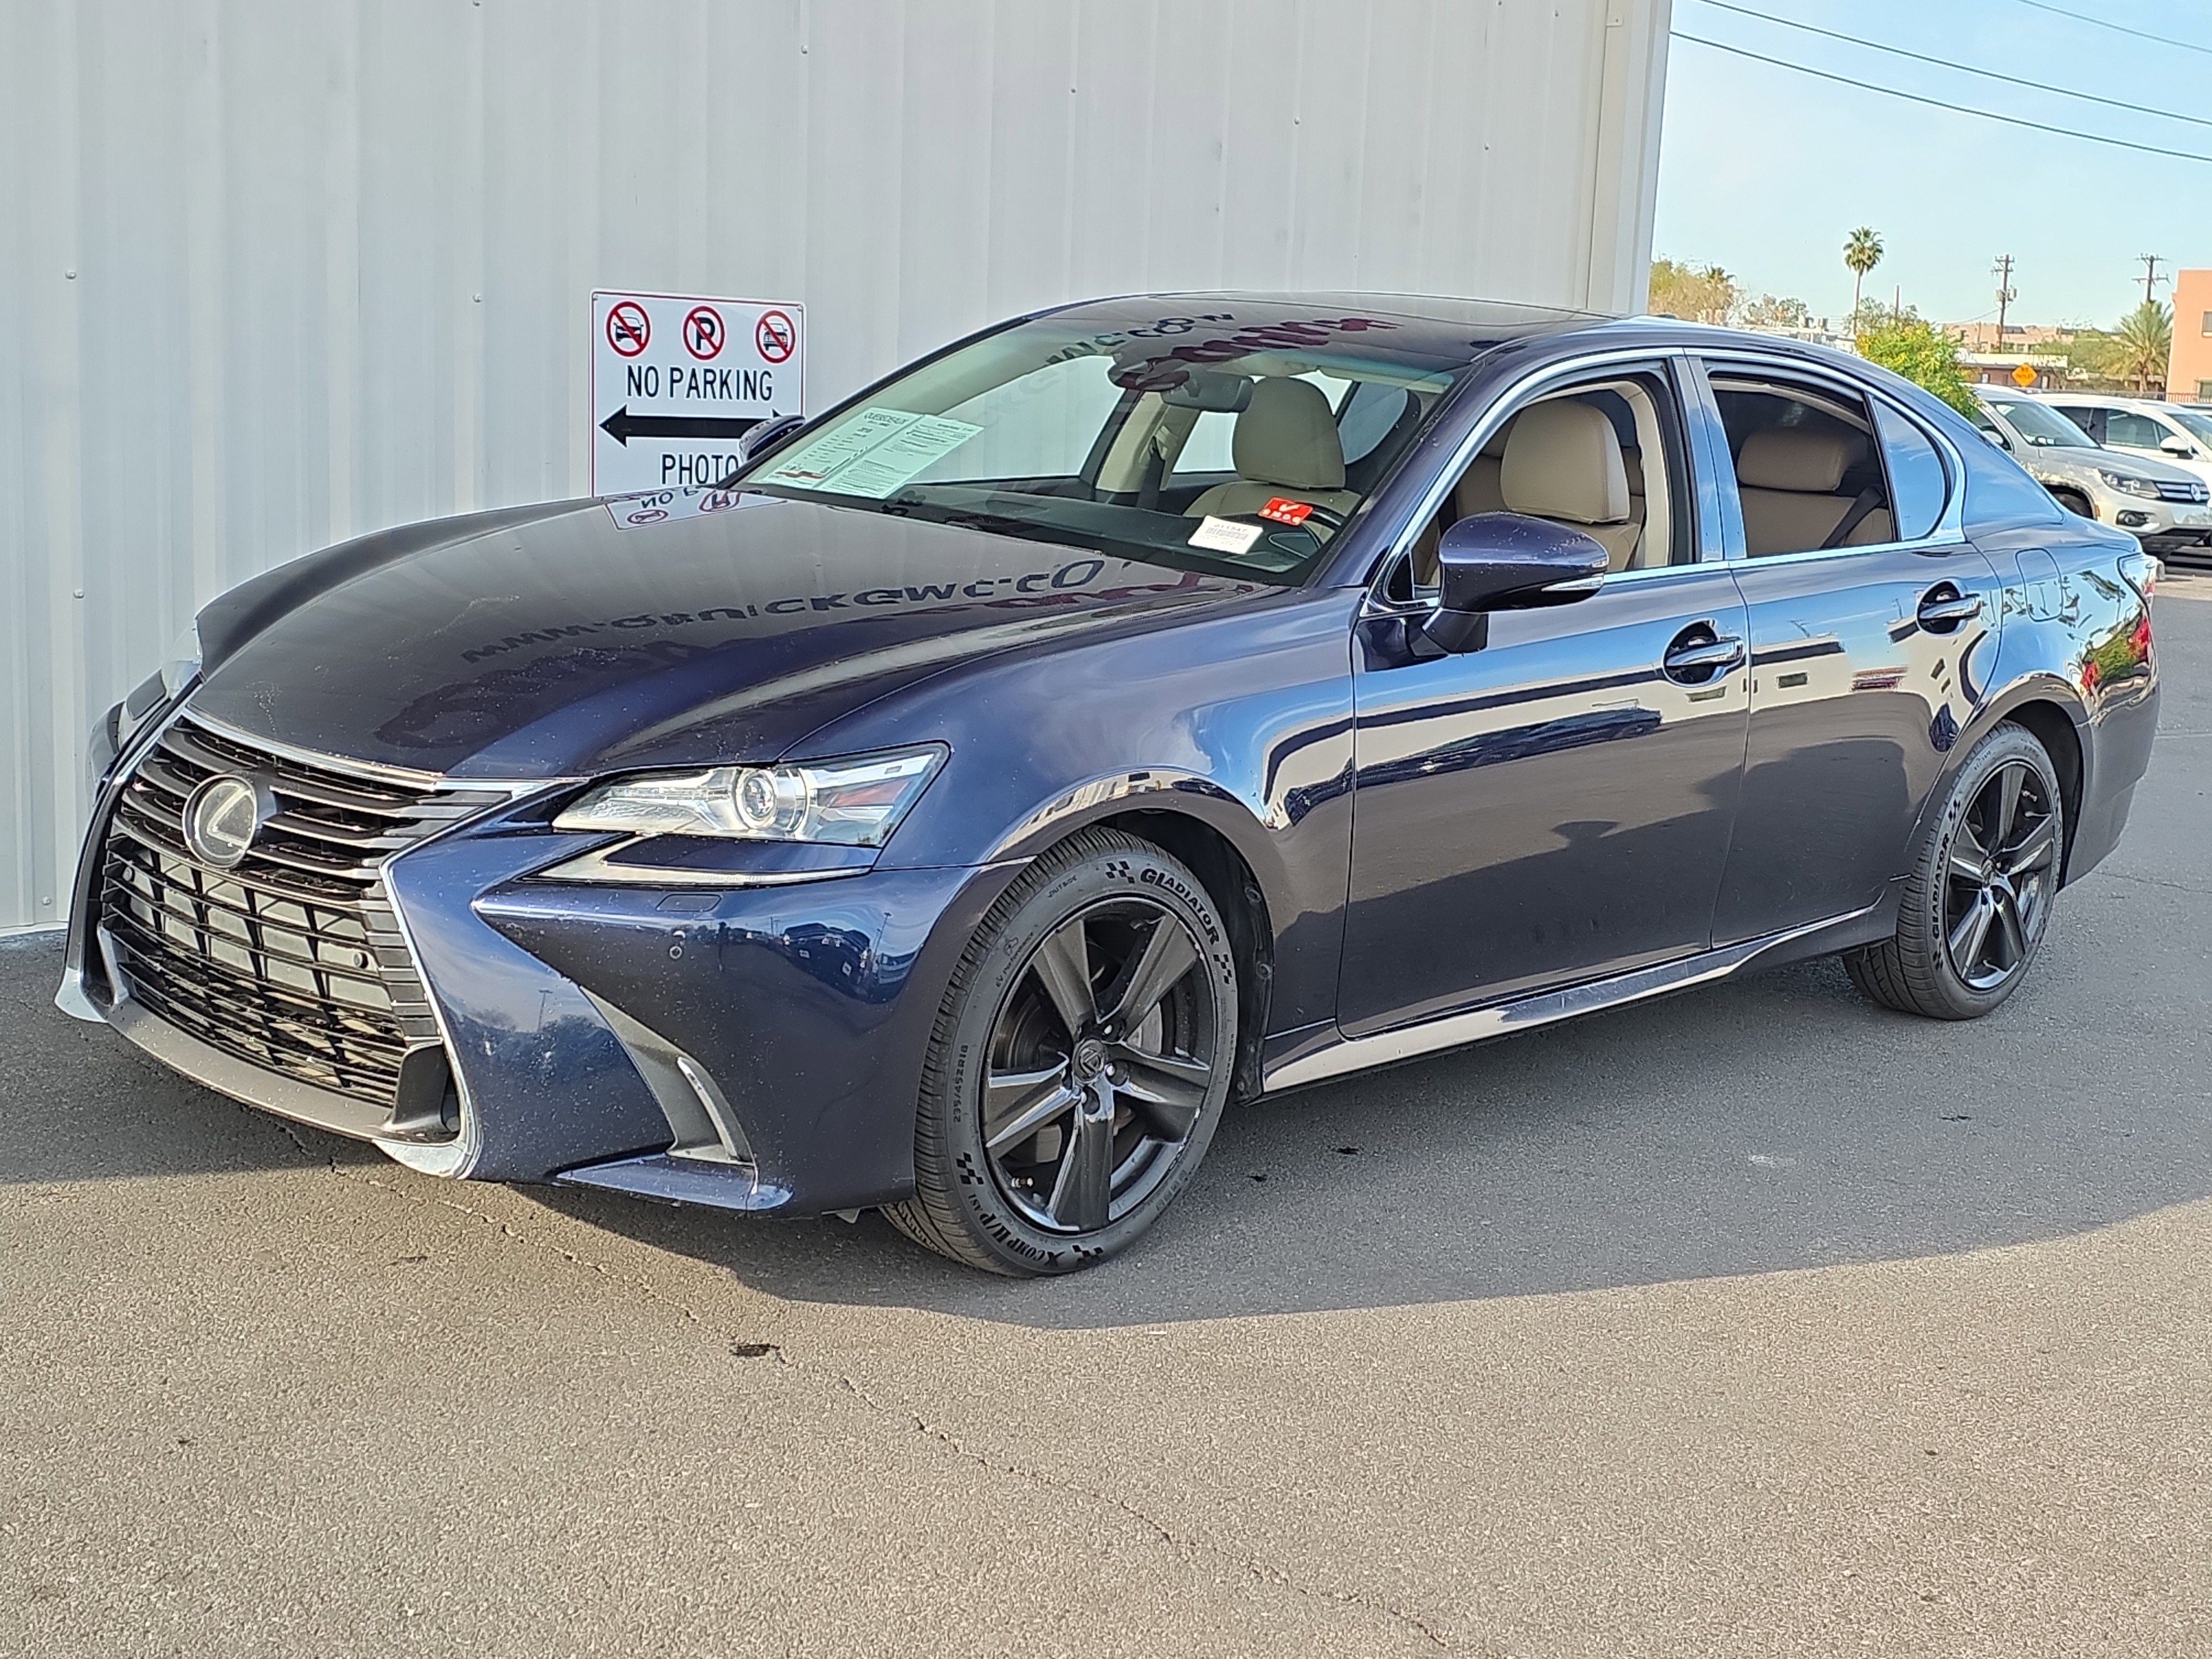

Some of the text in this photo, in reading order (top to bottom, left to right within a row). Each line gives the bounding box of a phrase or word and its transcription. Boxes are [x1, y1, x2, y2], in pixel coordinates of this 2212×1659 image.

[695, 316, 716, 351] P
[627, 364, 773, 401] NO PARKING
[661, 453, 739, 485] PHOTO
[1932, 832, 1950, 940] GLADIATOR
[1140, 868, 1220, 946] GLADIATOR
